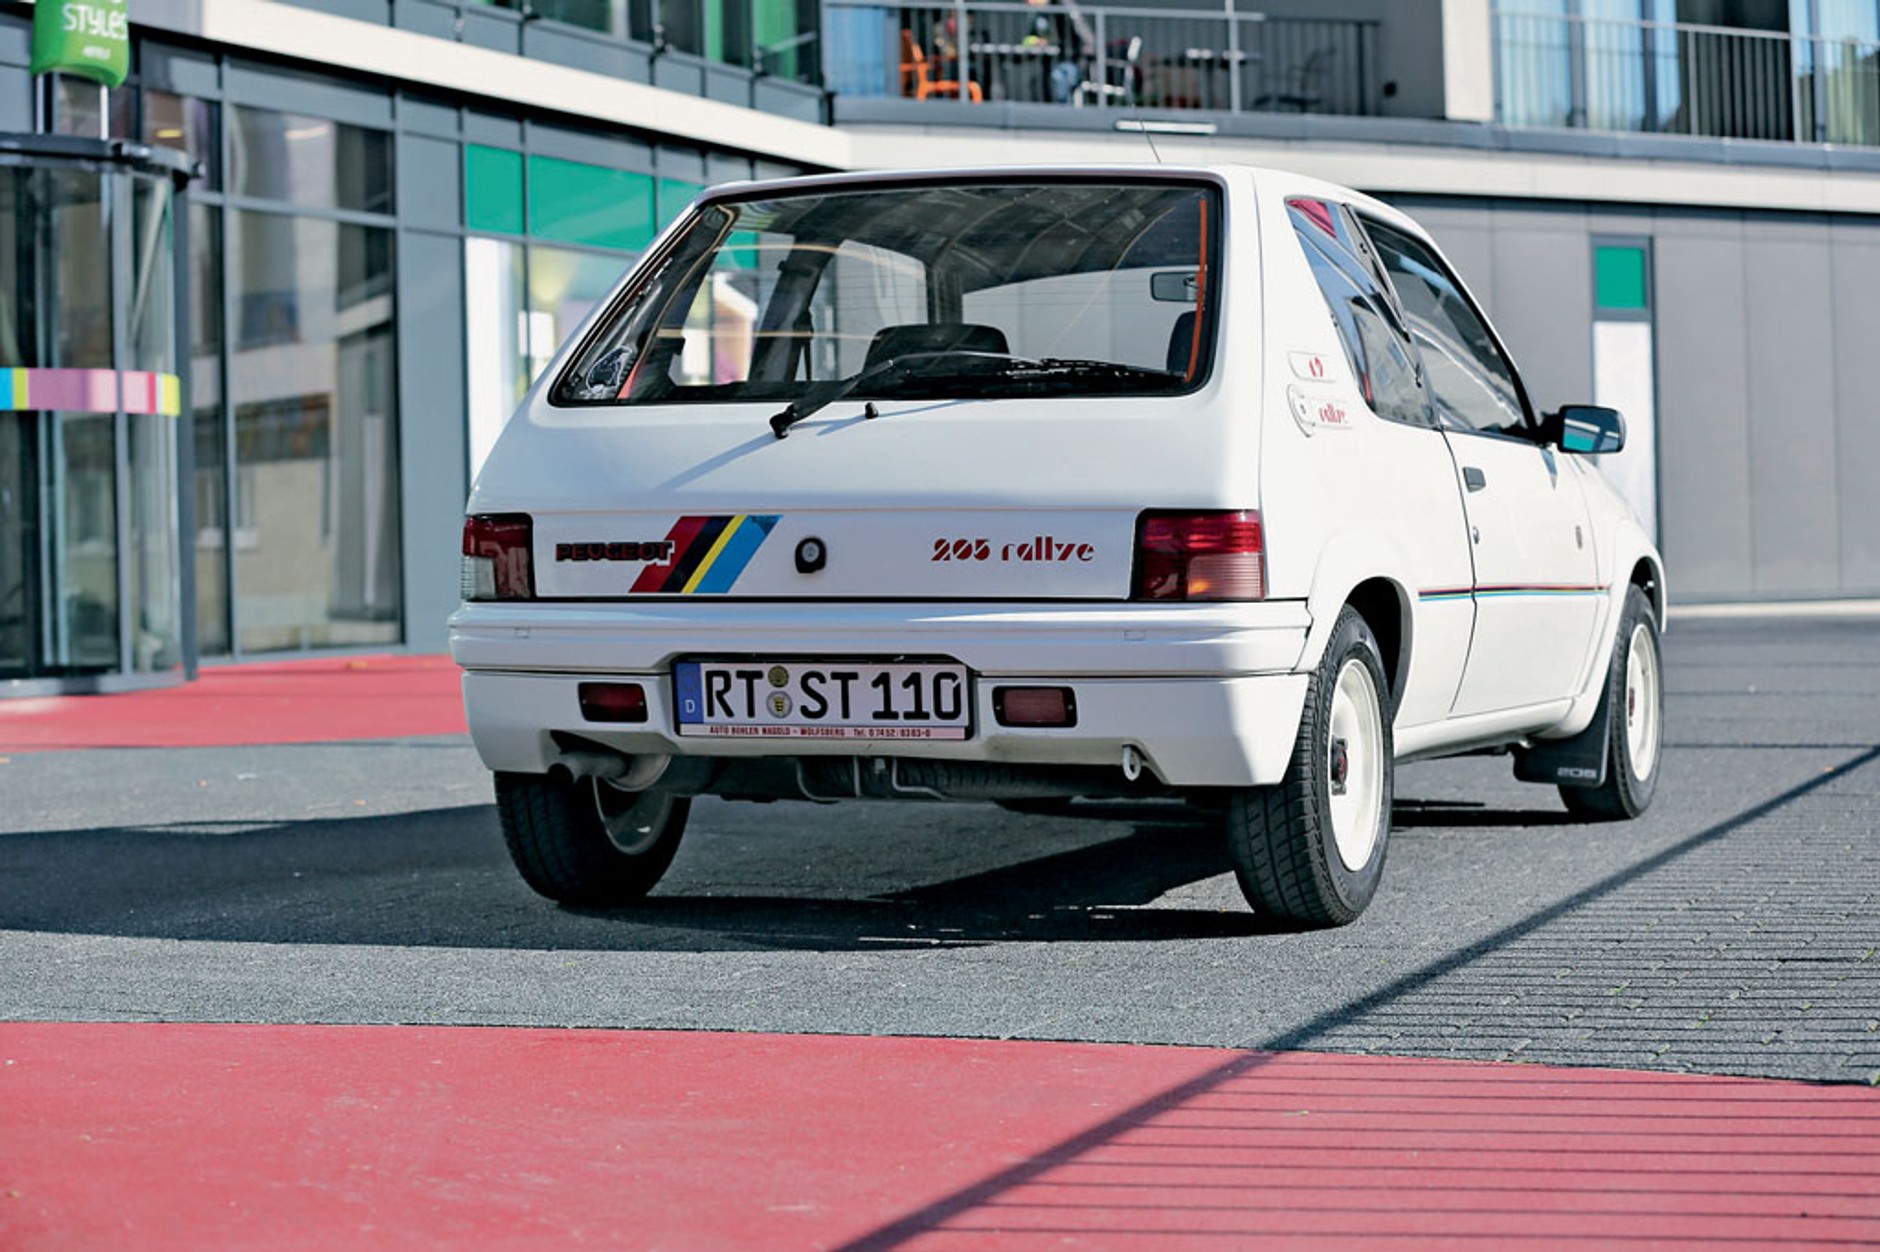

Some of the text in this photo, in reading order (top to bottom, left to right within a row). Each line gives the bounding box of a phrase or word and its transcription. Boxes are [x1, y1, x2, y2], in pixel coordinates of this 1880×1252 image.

[556, 541, 673, 562] PEUGEOT
[931, 536, 1095, 562] 205 rallye
[705, 670, 962, 721] RT ST 110
[685, 699, 696, 714] D
[709, 725, 730, 736] AUTO
